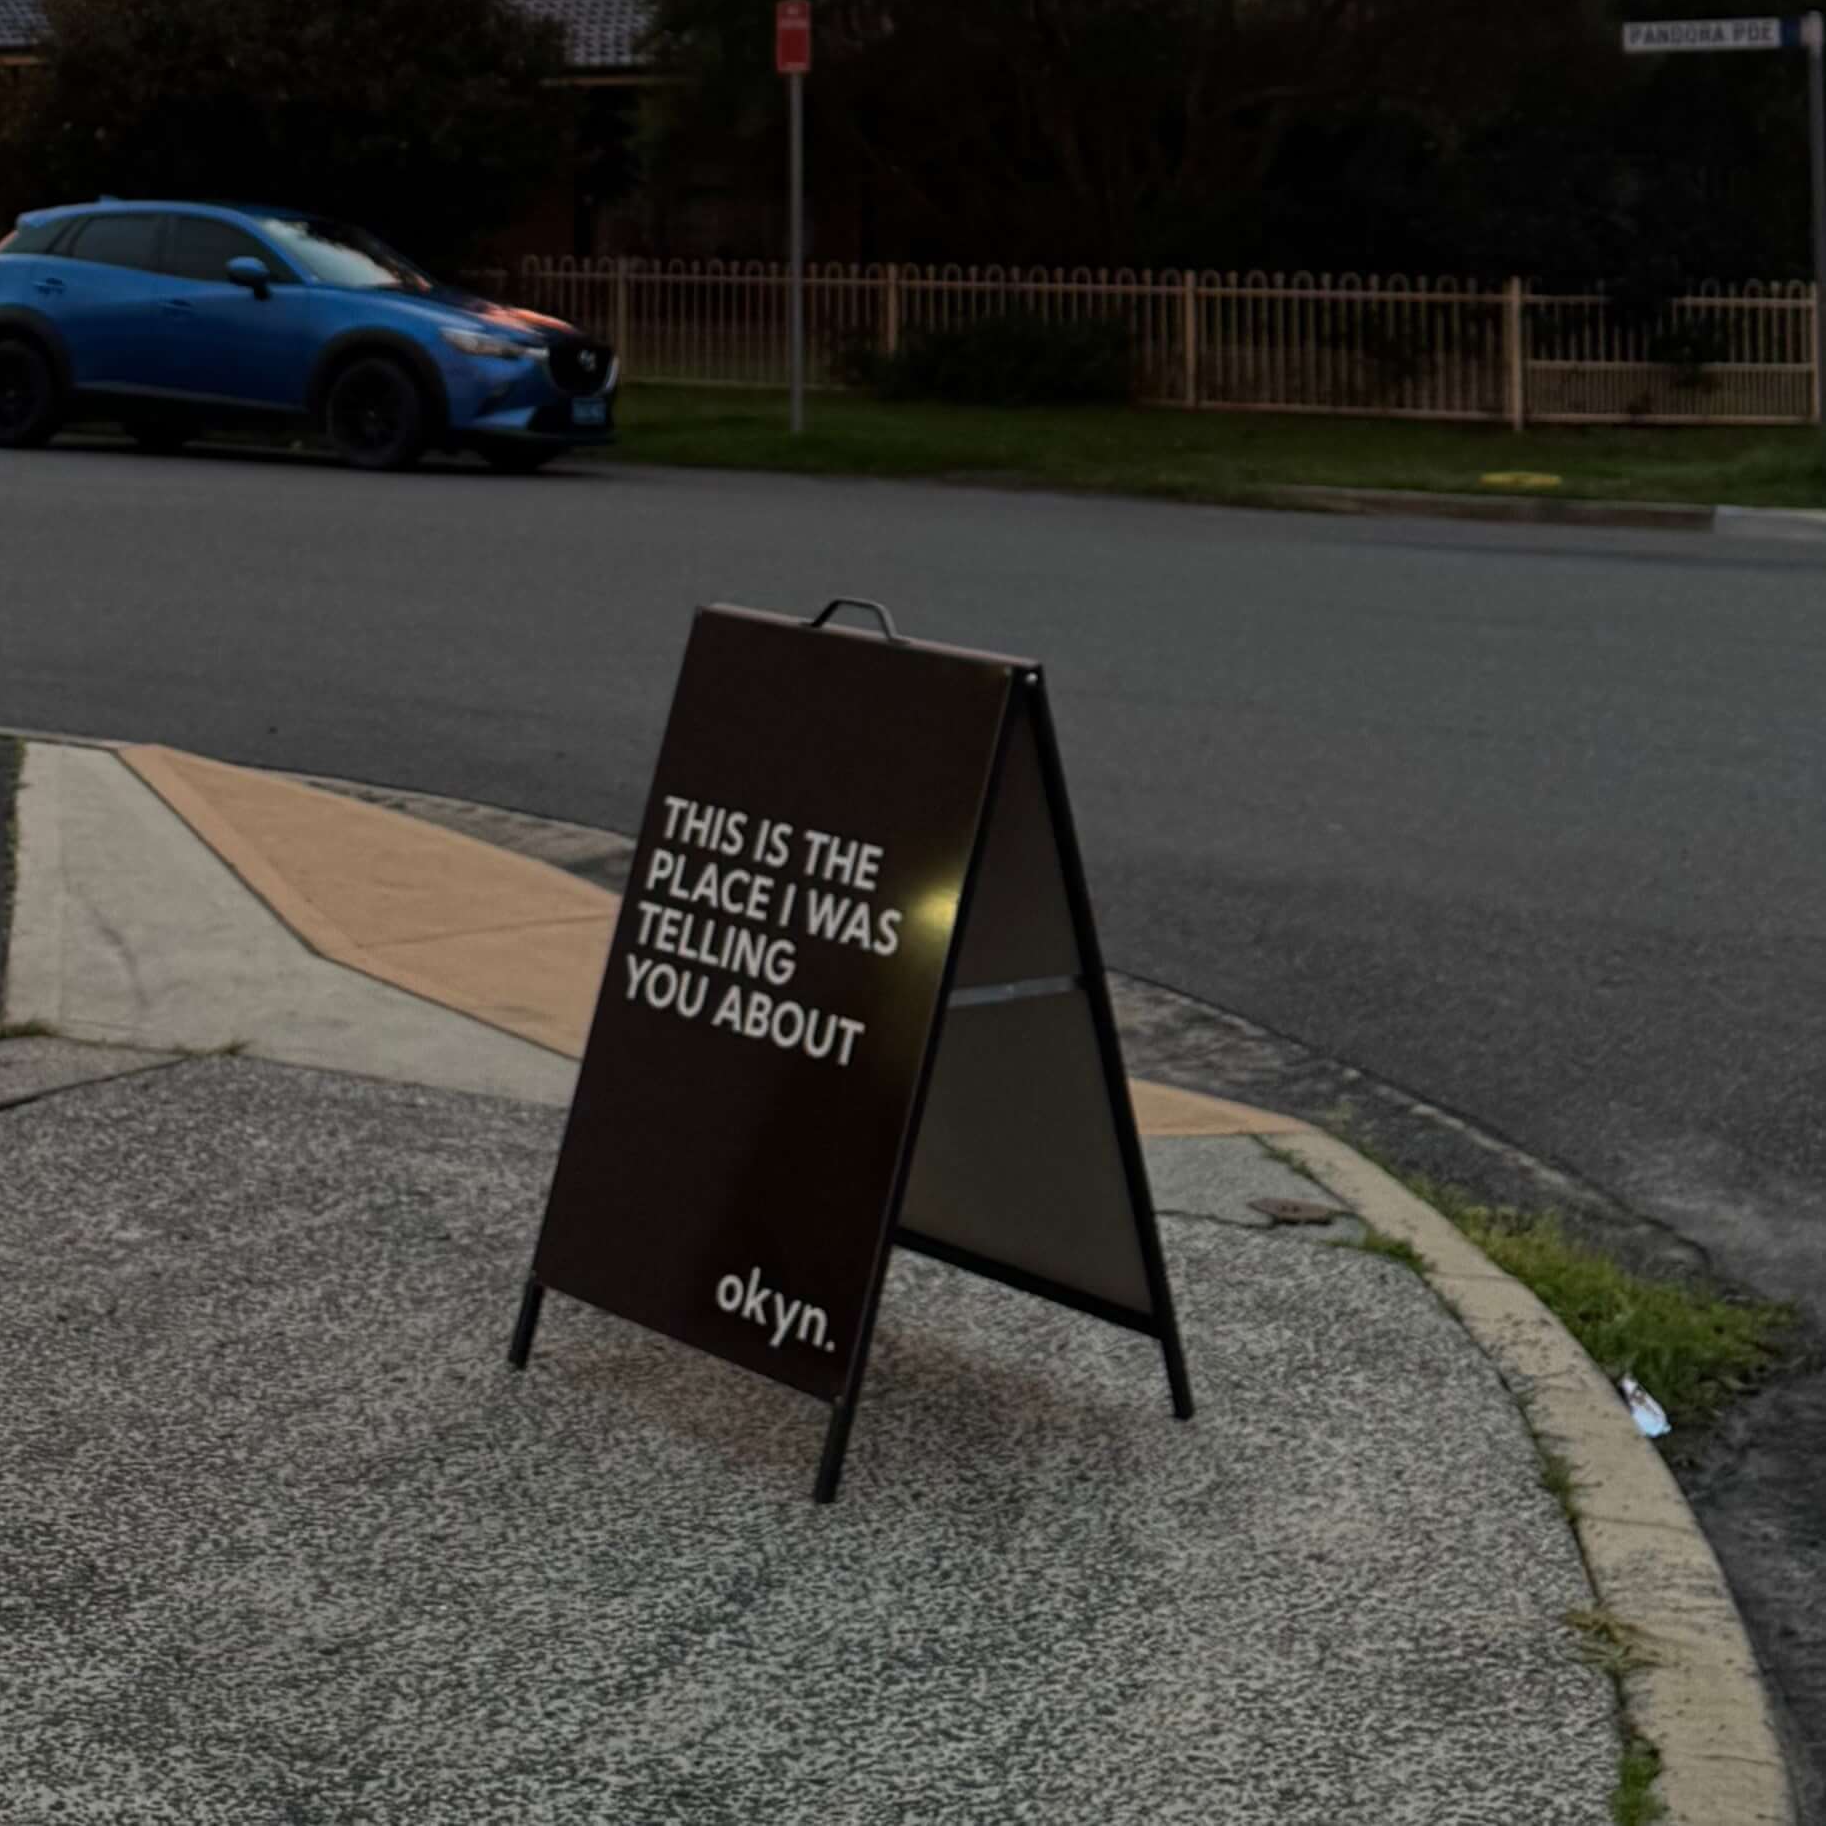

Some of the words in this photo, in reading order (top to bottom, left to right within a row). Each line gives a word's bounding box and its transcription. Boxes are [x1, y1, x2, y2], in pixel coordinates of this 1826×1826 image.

[1629, 24, 1724, 45] PANDORA
[1731, 22, 1774, 42] PDE
[664, 795, 748, 856] THIS
[753, 819, 793, 867] IS
[804, 830, 884, 891] THE
[637, 901, 796, 985] TELLING
[646, 848, 774, 920] PLACE
[779, 882, 796, 926] I
[807, 888, 903, 955] WAS
[626, 953, 709, 1018] YOU
[711, 985, 865, 1066] ABOUT
[716, 1266, 836, 1352] okyn.
